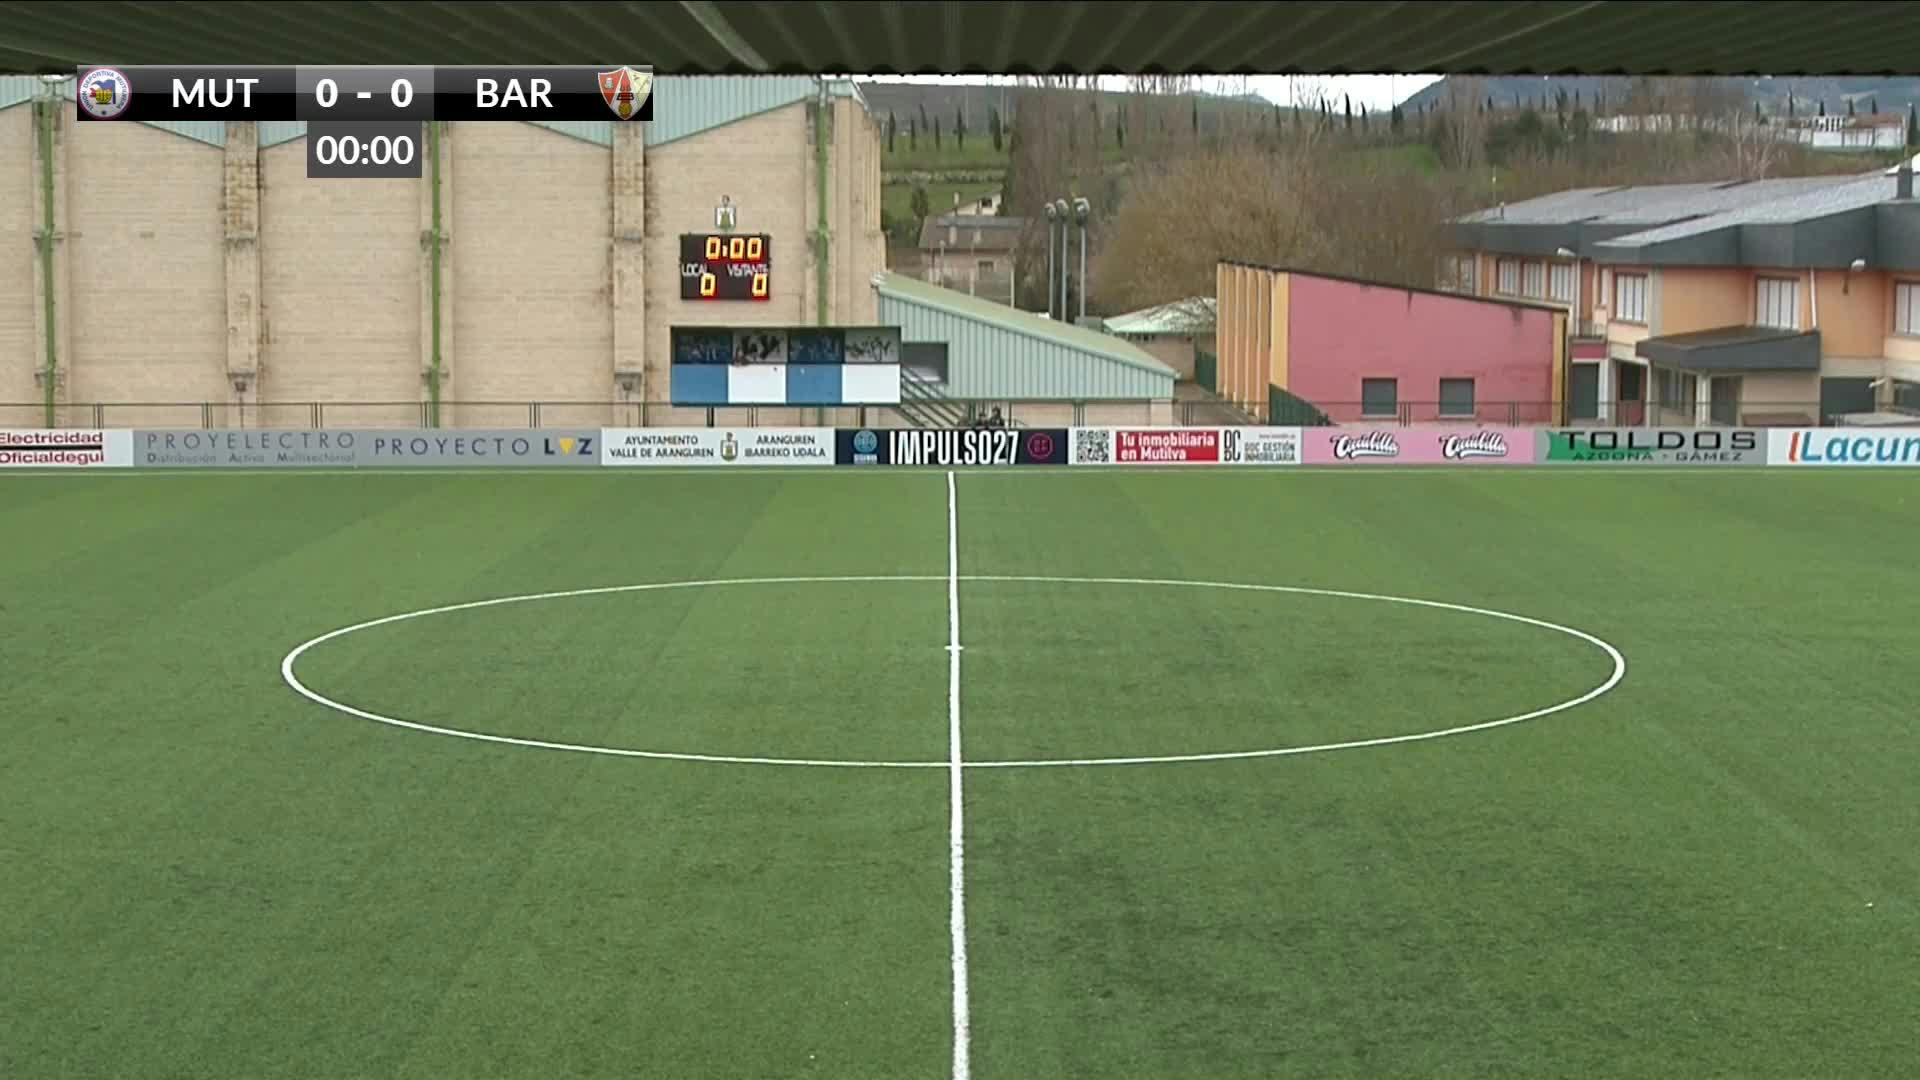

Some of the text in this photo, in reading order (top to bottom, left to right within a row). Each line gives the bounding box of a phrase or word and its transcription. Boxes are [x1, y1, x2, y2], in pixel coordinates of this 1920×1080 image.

[705, 236, 762, 260] 0:00
[681, 263, 708, 277] LOCAL
[700, 272, 716, 296] 0
[752, 272, 768, 296] 0
[0, 432, 103, 444] Electricidad
[147, 432, 354, 449] PROYELECTRO
[625, 435, 698, 445] AYUNTAMIENTO
[756, 435, 816, 445] ARANGUREN
[1121, 432, 1215, 447] Tu inmobiliaria
[1560, 431, 1756, 450] TOLDOS
[375, 438, 529, 455] PROYECTO
[609, 448, 714, 457] VALLE DE ARANGUREN
[793, 447, 826, 457] UDALA
[889, 431, 1020, 464] IMPULSO27
[1121, 447, 1187, 460] en Mutilva
[0, 452, 104, 465] Oficialdegui
